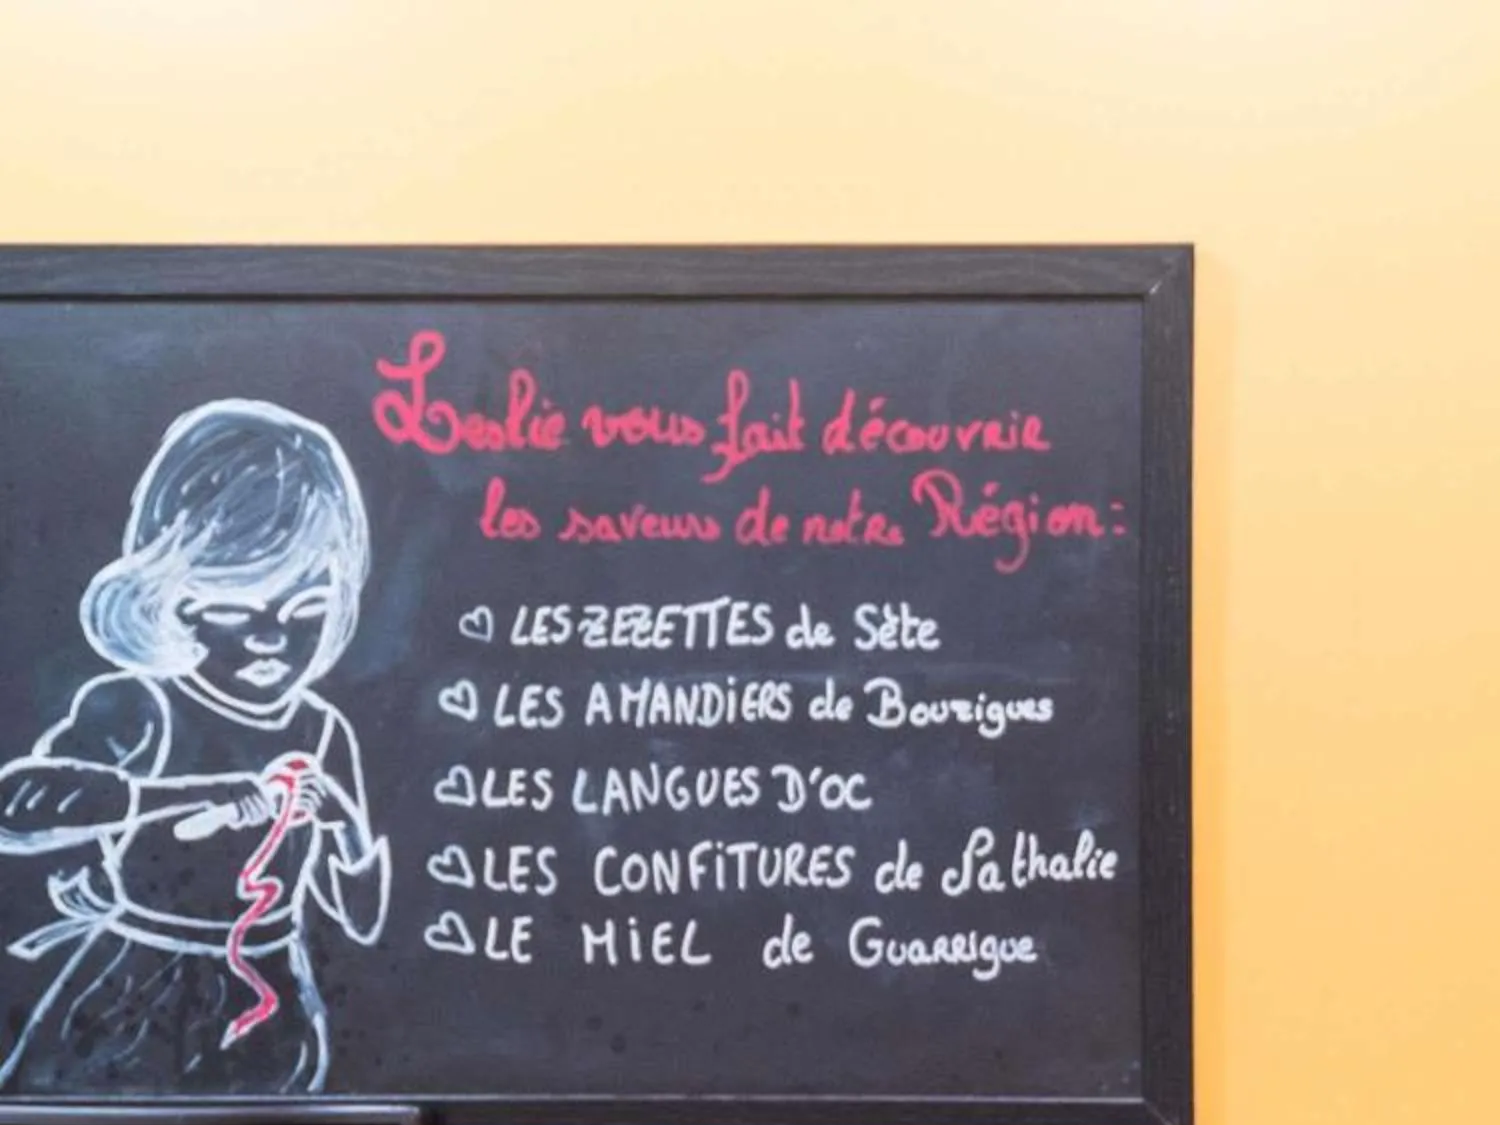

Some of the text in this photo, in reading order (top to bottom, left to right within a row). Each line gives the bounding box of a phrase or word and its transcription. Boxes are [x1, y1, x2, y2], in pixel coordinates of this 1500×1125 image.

[374, 330, 567, 454] Leslie
[582, 404, 707, 447] vous
[701, 369, 805, 483] fait
[480, 475, 541, 541] les
[736, 485, 789, 547] de
[803, 487, 905, 546] notre
[510, 596, 941, 651] LES ZEZETTES de Sète
[493, 683, 565, 728] LES
[808, 676, 854, 722] de
[863, 676, 1054, 739] Bouzigues
[482, 762, 873, 816] LES LANGUES D'OC
[483, 845, 558, 896] LES
[874, 838, 924, 894] de
[485, 915, 533, 964] LE
[762, 912, 814, 969] de
